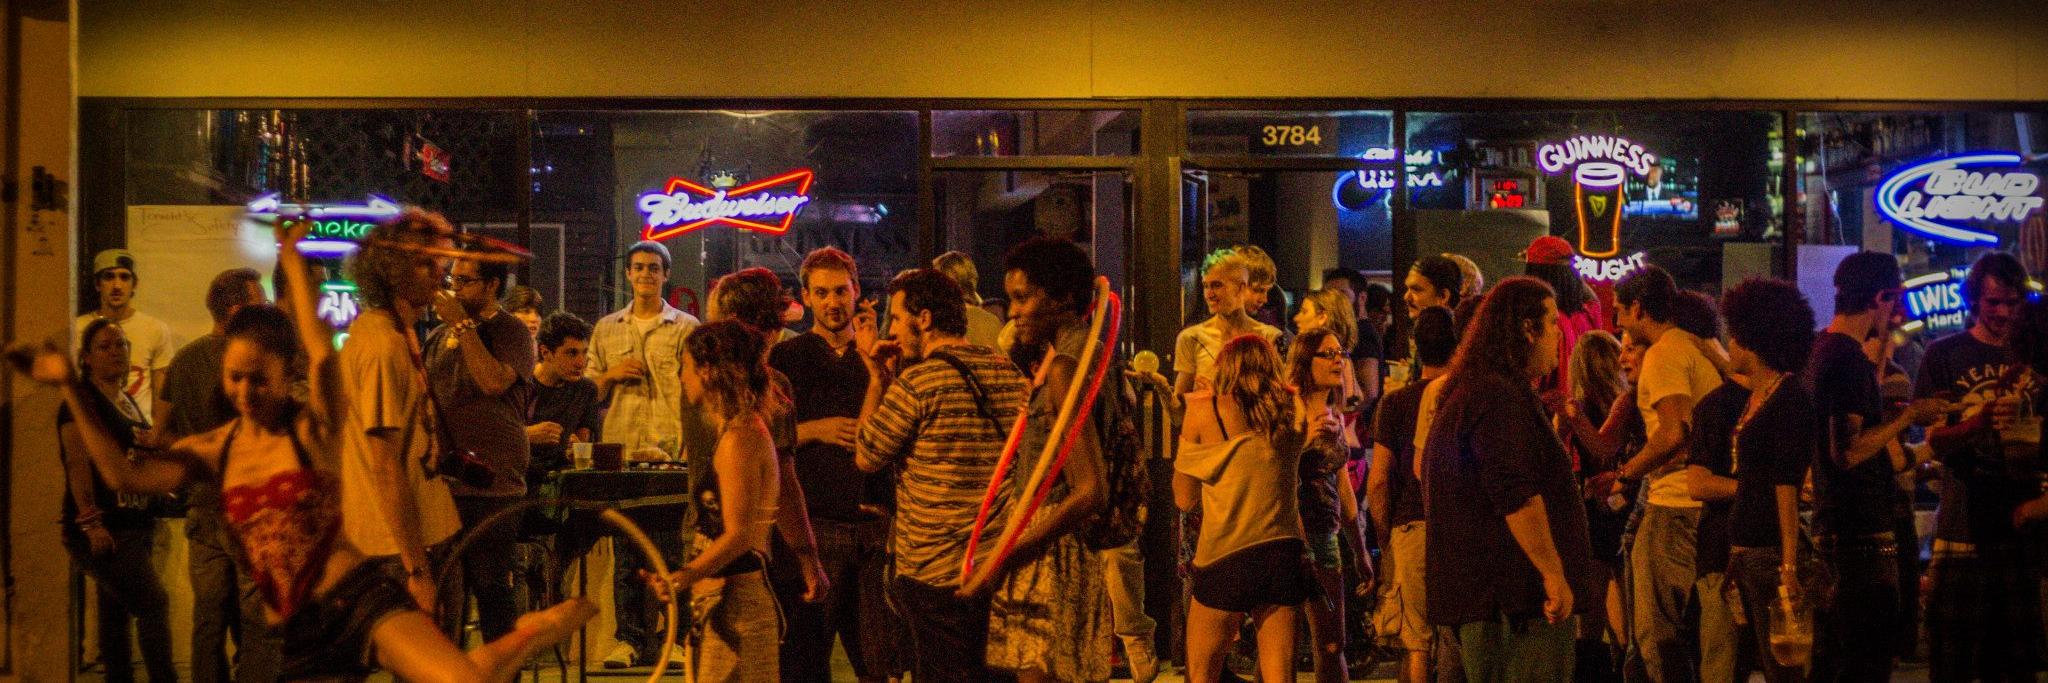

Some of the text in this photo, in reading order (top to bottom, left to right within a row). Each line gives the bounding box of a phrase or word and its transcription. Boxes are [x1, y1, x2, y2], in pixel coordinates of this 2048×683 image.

[1263, 125, 1322, 146] 3784
[1538, 135, 1655, 176] GUINNESS
[639, 191, 809, 226] Budweiser
[1927, 310, 1963, 330] Hard
